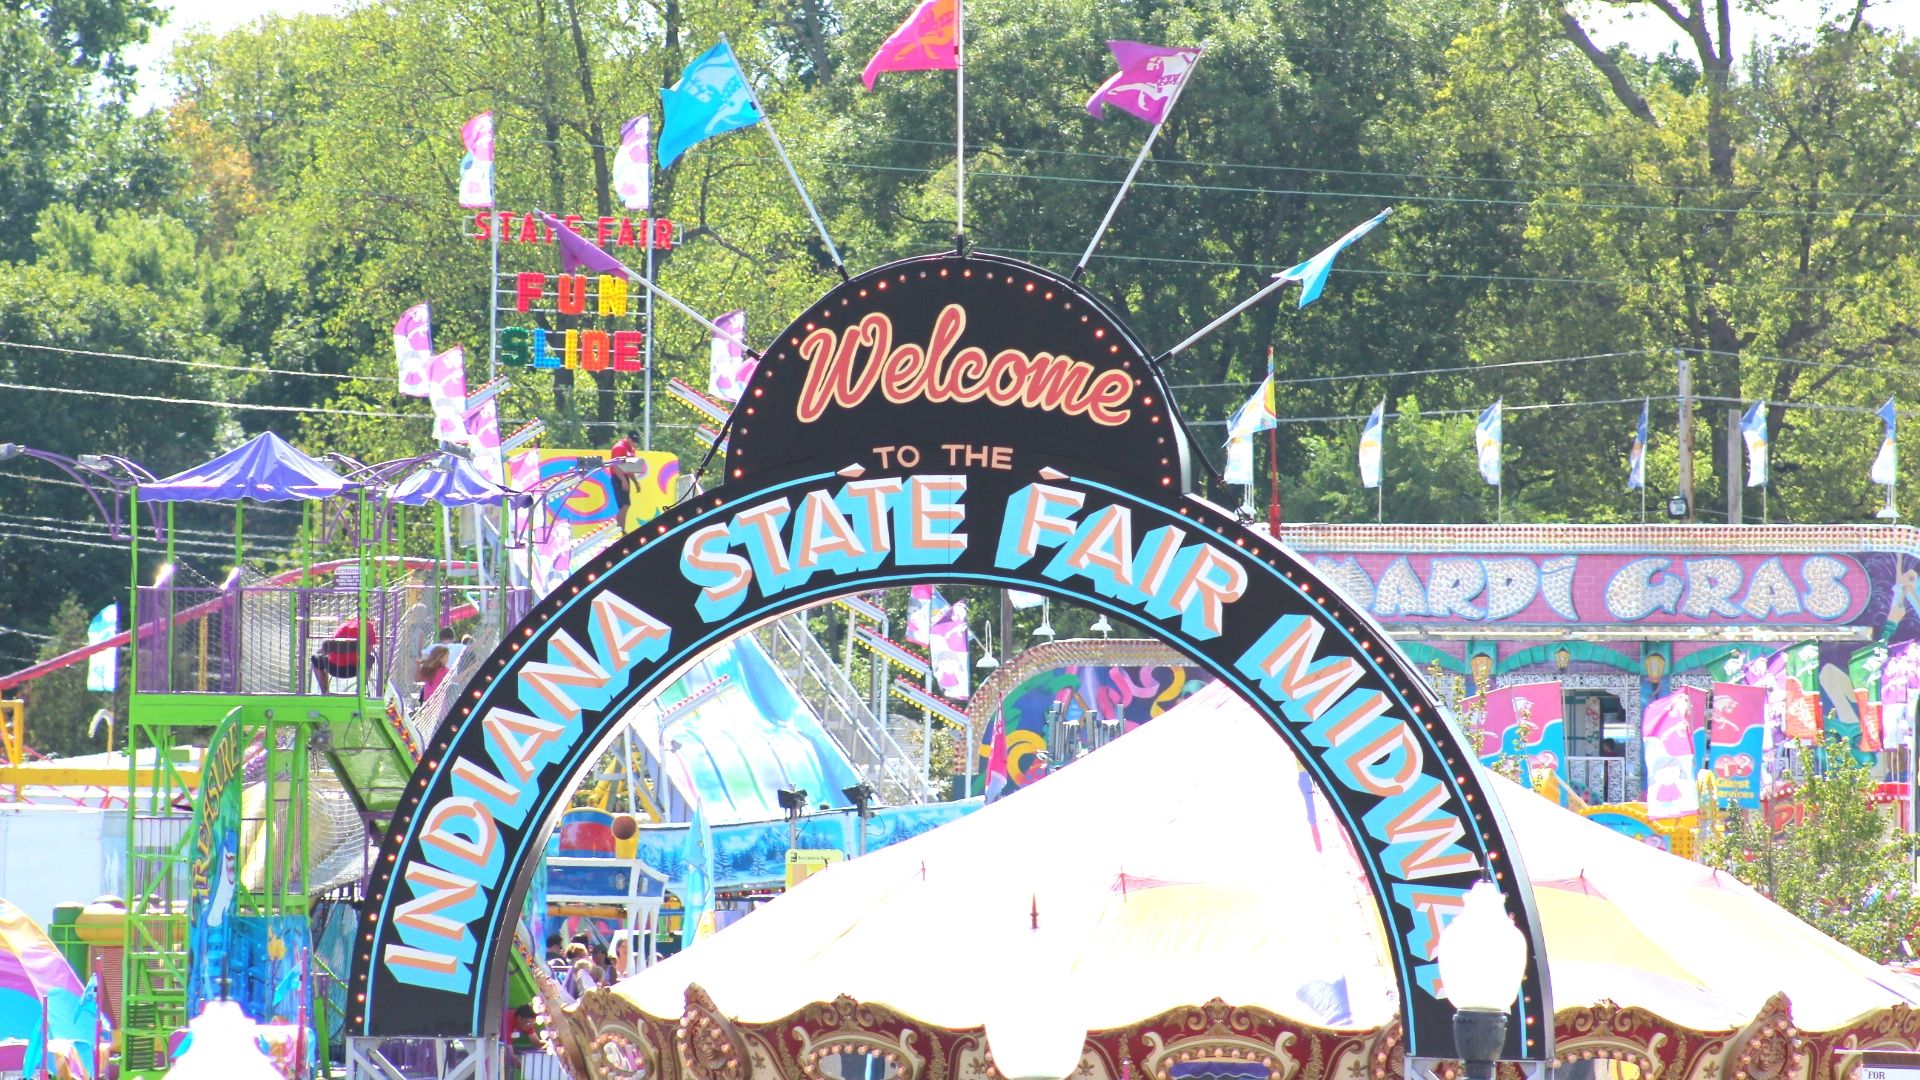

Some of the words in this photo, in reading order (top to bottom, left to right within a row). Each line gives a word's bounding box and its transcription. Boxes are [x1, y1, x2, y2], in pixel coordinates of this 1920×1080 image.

[597, 217, 673, 250] FAIR
[516, 272, 628, 317] FUN
[501, 326, 642, 372] SLIDE
[797, 303, 1134, 426] Welcome
[872, 446, 920, 469] TO
[942, 444, 1014, 470] THE
[1606, 556, 1852, 621] GRAS
[384, 589, 671, 994] INDIANA
[680, 474, 968, 623] STATE
[994, 482, 1248, 641] FAIR
[1233, 613, 1482, 999] MIDWA
[1867, 1071, 1886, 1080] FOR
